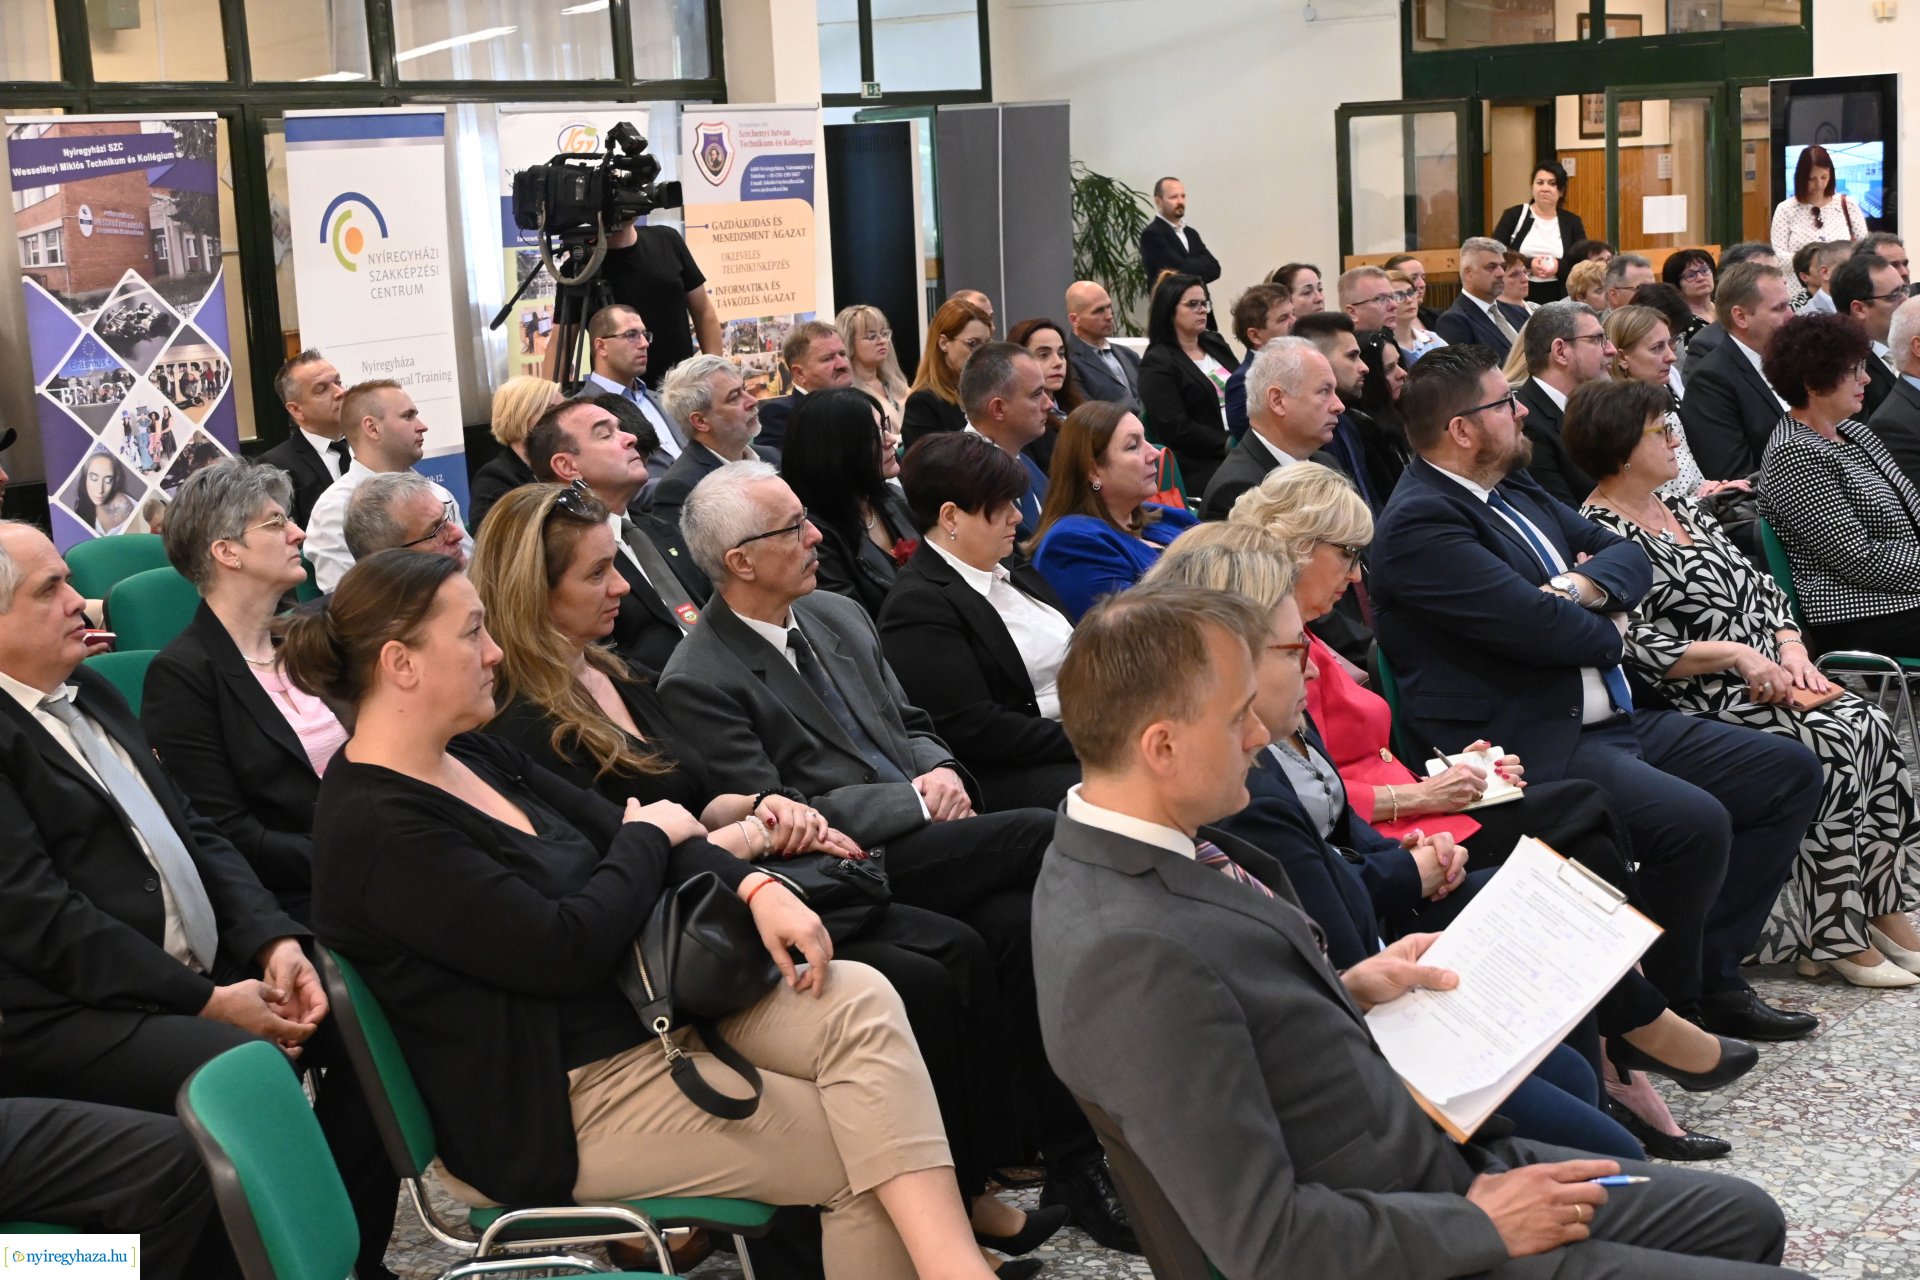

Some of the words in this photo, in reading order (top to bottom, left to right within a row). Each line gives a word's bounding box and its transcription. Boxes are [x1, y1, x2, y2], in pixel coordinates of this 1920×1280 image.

[108, 142, 124, 152] SZC
[12, 163, 59, 177] Wesselényi
[60, 159, 85, 172] Miklós
[86, 155, 126, 168] Technikum
[127, 154, 137, 164] és
[137, 152, 175, 163] Kollégium
[712, 216, 771, 230] GAZDÁLKODÁS
[772, 216, 783, 226] ÉS
[712, 230, 770, 243] MENEDZSMENT
[772, 227, 807, 239] ÁGAZAT
[368, 246, 439, 265] NYÍREGYHÁZI
[369, 263, 440, 282] SZAKKÉPZÉSI
[370, 283, 424, 300] CENTRUM
[715, 282, 771, 296] INFORMATIKA
[771, 280, 781, 290] ÉS
[761, 291, 797, 304] ÁGAZAT
[415, 369, 453, 385] Training
